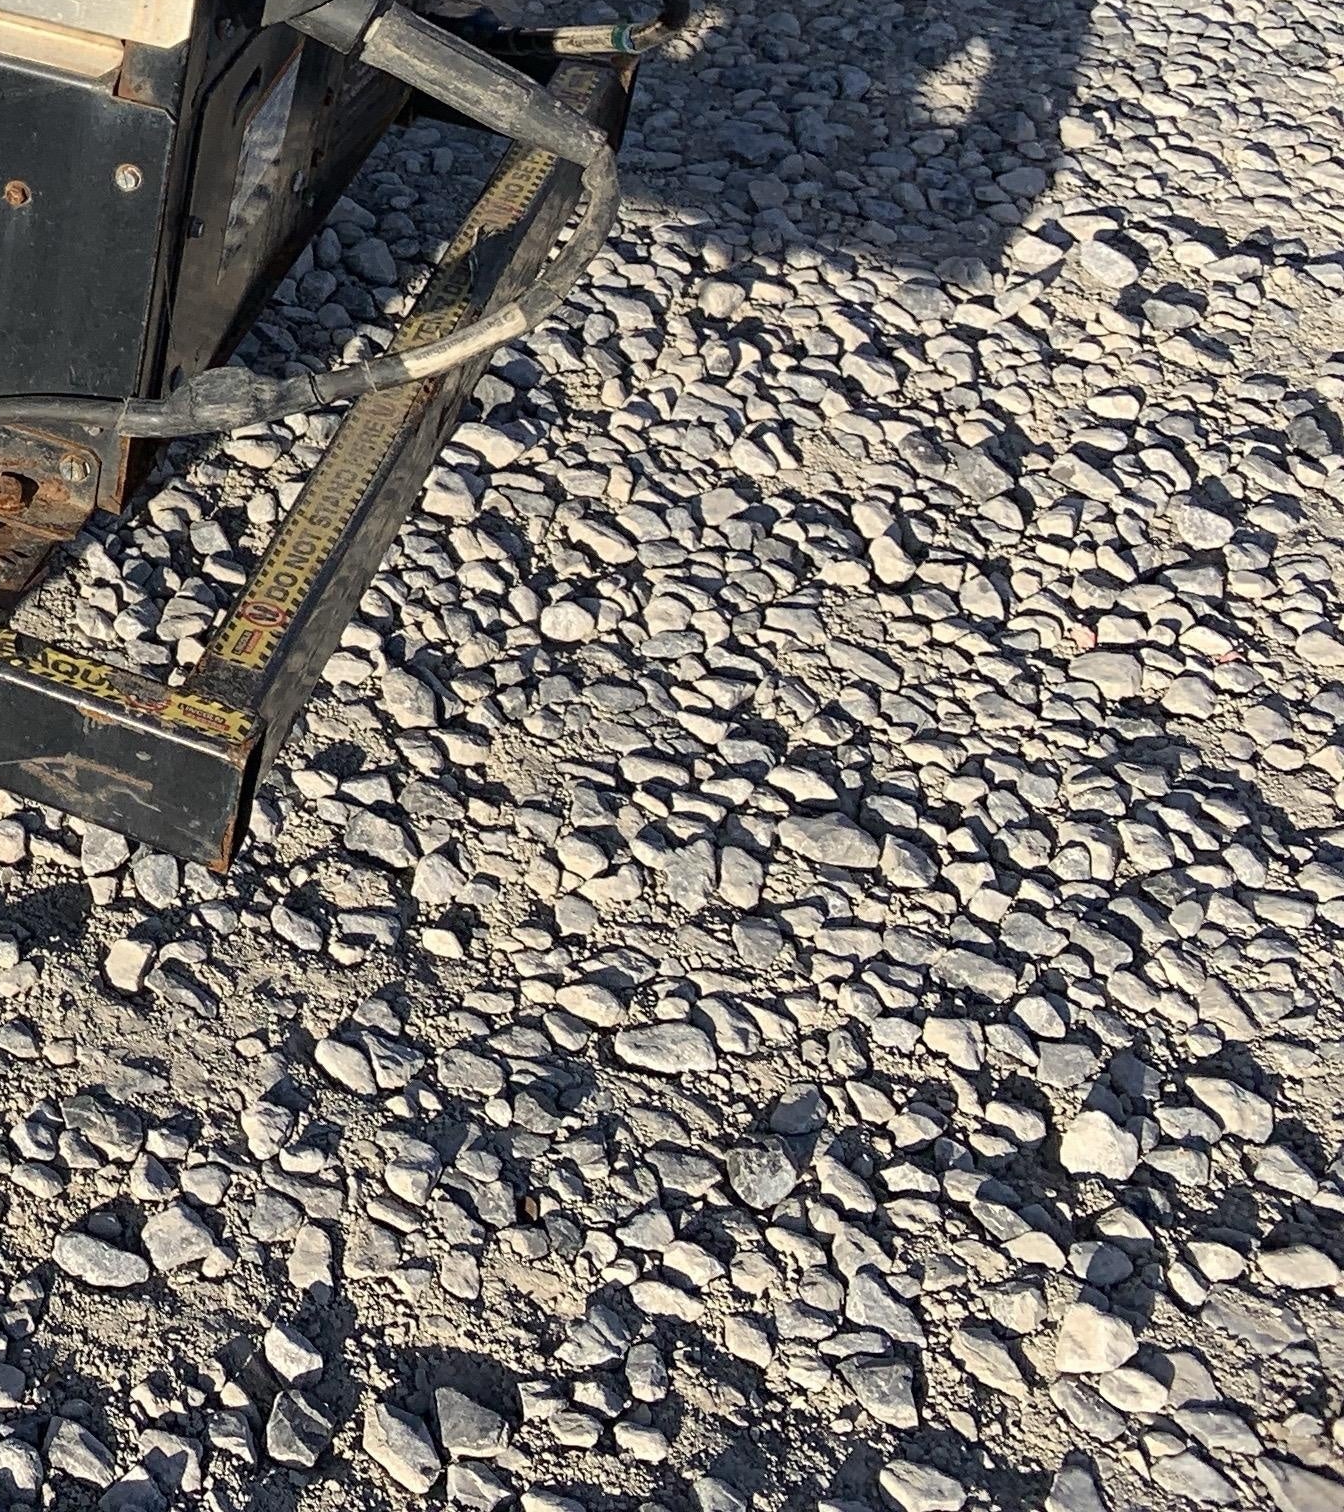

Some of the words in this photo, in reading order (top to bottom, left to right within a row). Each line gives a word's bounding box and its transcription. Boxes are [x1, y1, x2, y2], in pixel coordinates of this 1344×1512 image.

[264, 571, 299, 603] DO
[290, 528, 320, 571] NOT
[311, 468, 359, 529] STAND
